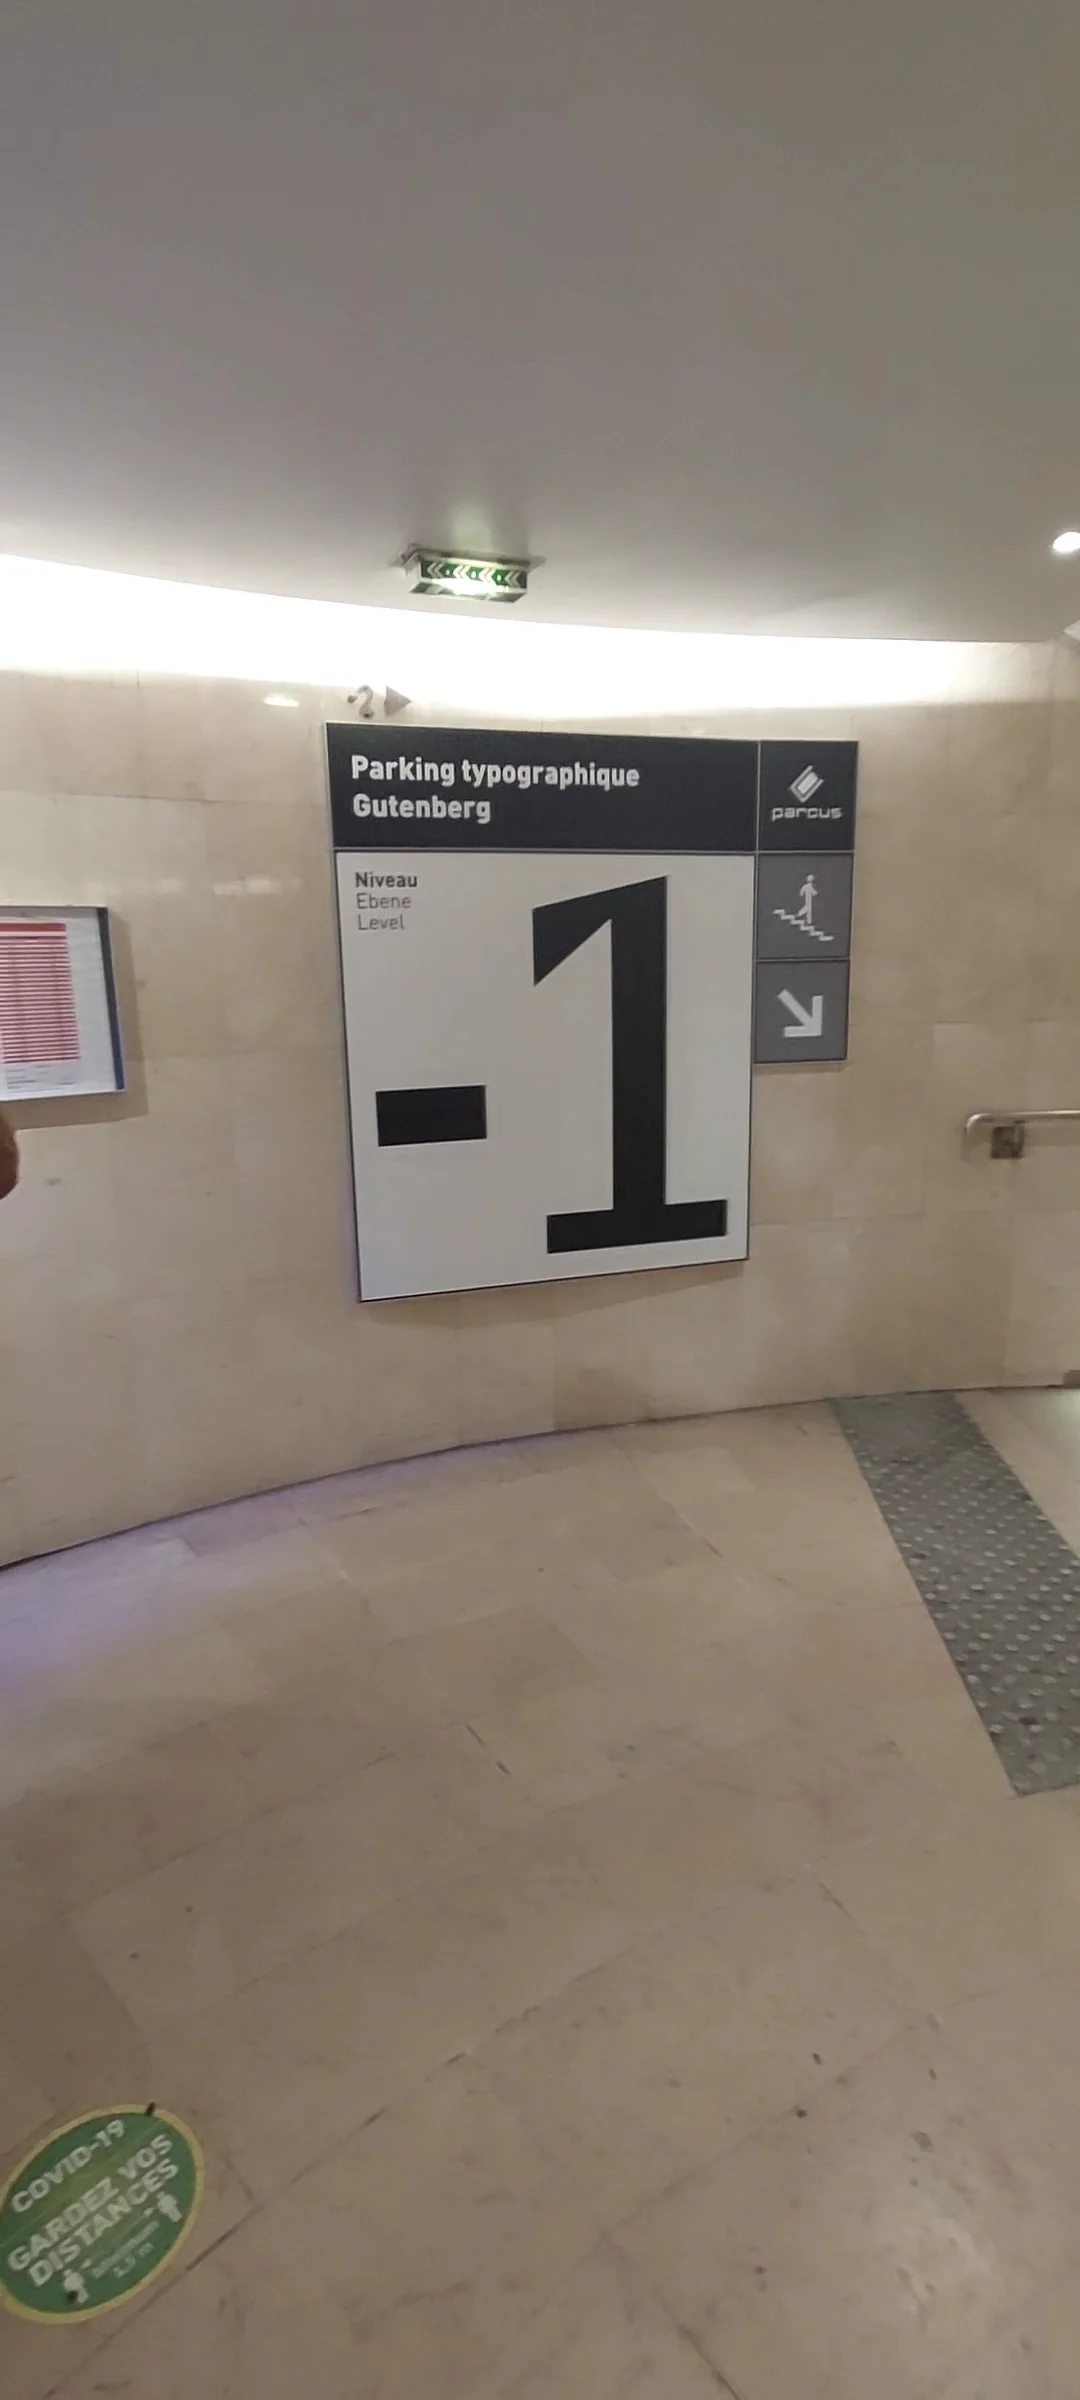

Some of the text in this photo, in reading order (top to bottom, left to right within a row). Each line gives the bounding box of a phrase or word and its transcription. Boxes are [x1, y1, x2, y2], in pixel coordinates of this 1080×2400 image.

[351, 754, 640, 791] Parking typographique
[352, 793, 491, 824] Gutenberg
[771, 807, 842, 822] parcus
[355, 871, 418, 888] Niveau
[356, 893, 412, 909] Ebene
[357, 915, 405, 931] Level
[11, 2119, 125, 2213] COVID-19
[8, 2133, 173, 2271] GARDEZ VOS
[28, 2158, 179, 2287] DISTANCES
